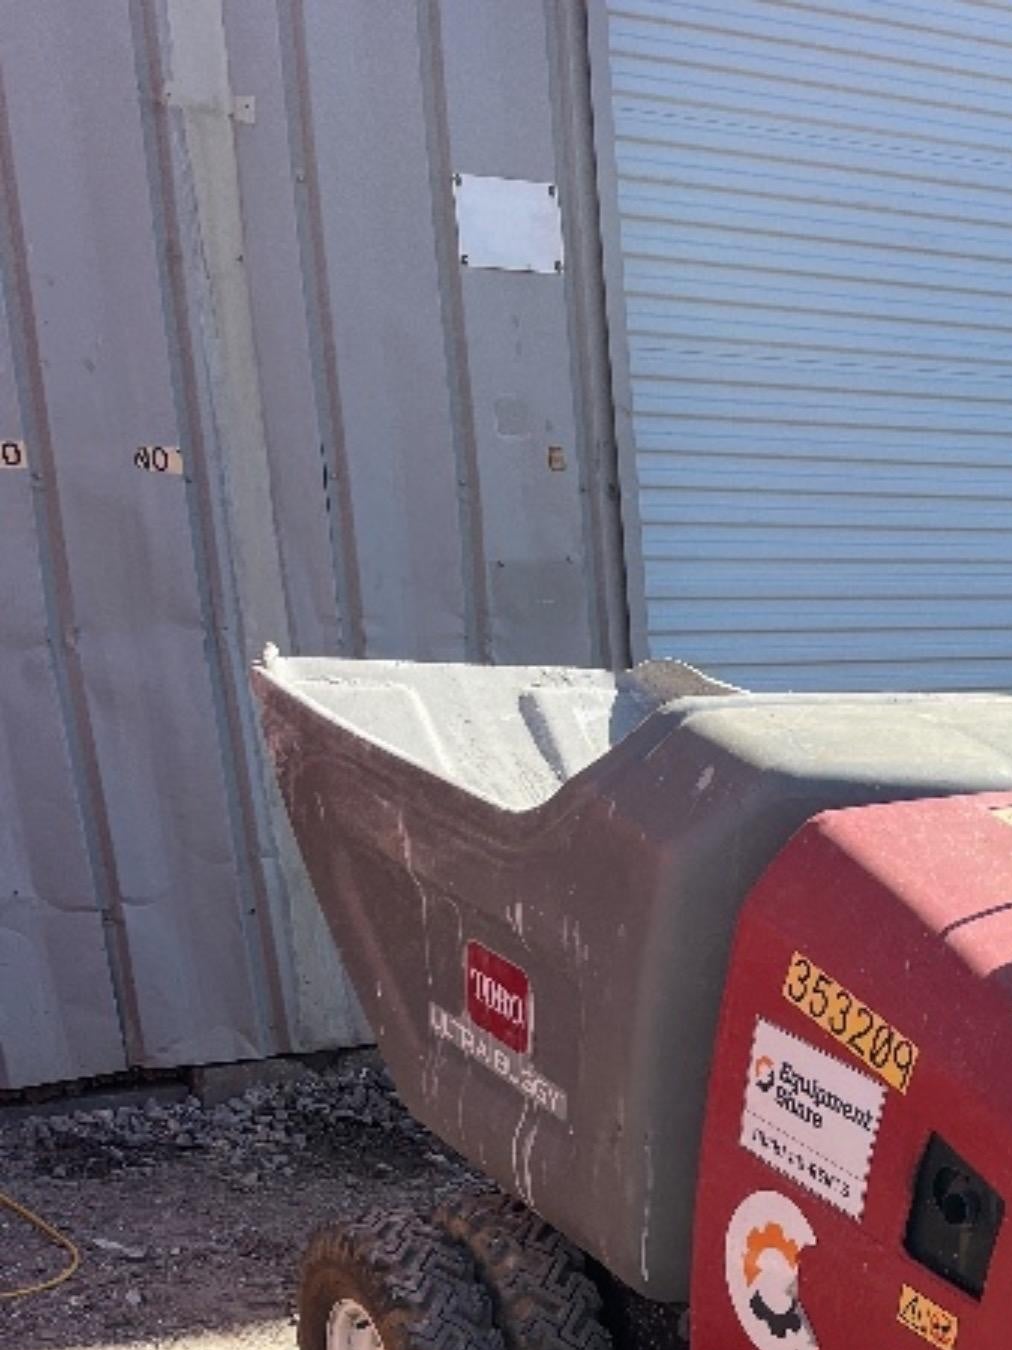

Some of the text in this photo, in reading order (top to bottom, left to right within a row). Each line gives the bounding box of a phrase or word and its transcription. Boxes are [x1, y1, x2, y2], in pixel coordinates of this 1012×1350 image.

[788, 958, 913, 1090] 353209
[775, 1085, 824, 1129] Share
[778, 1061, 874, 1131] Equipment
